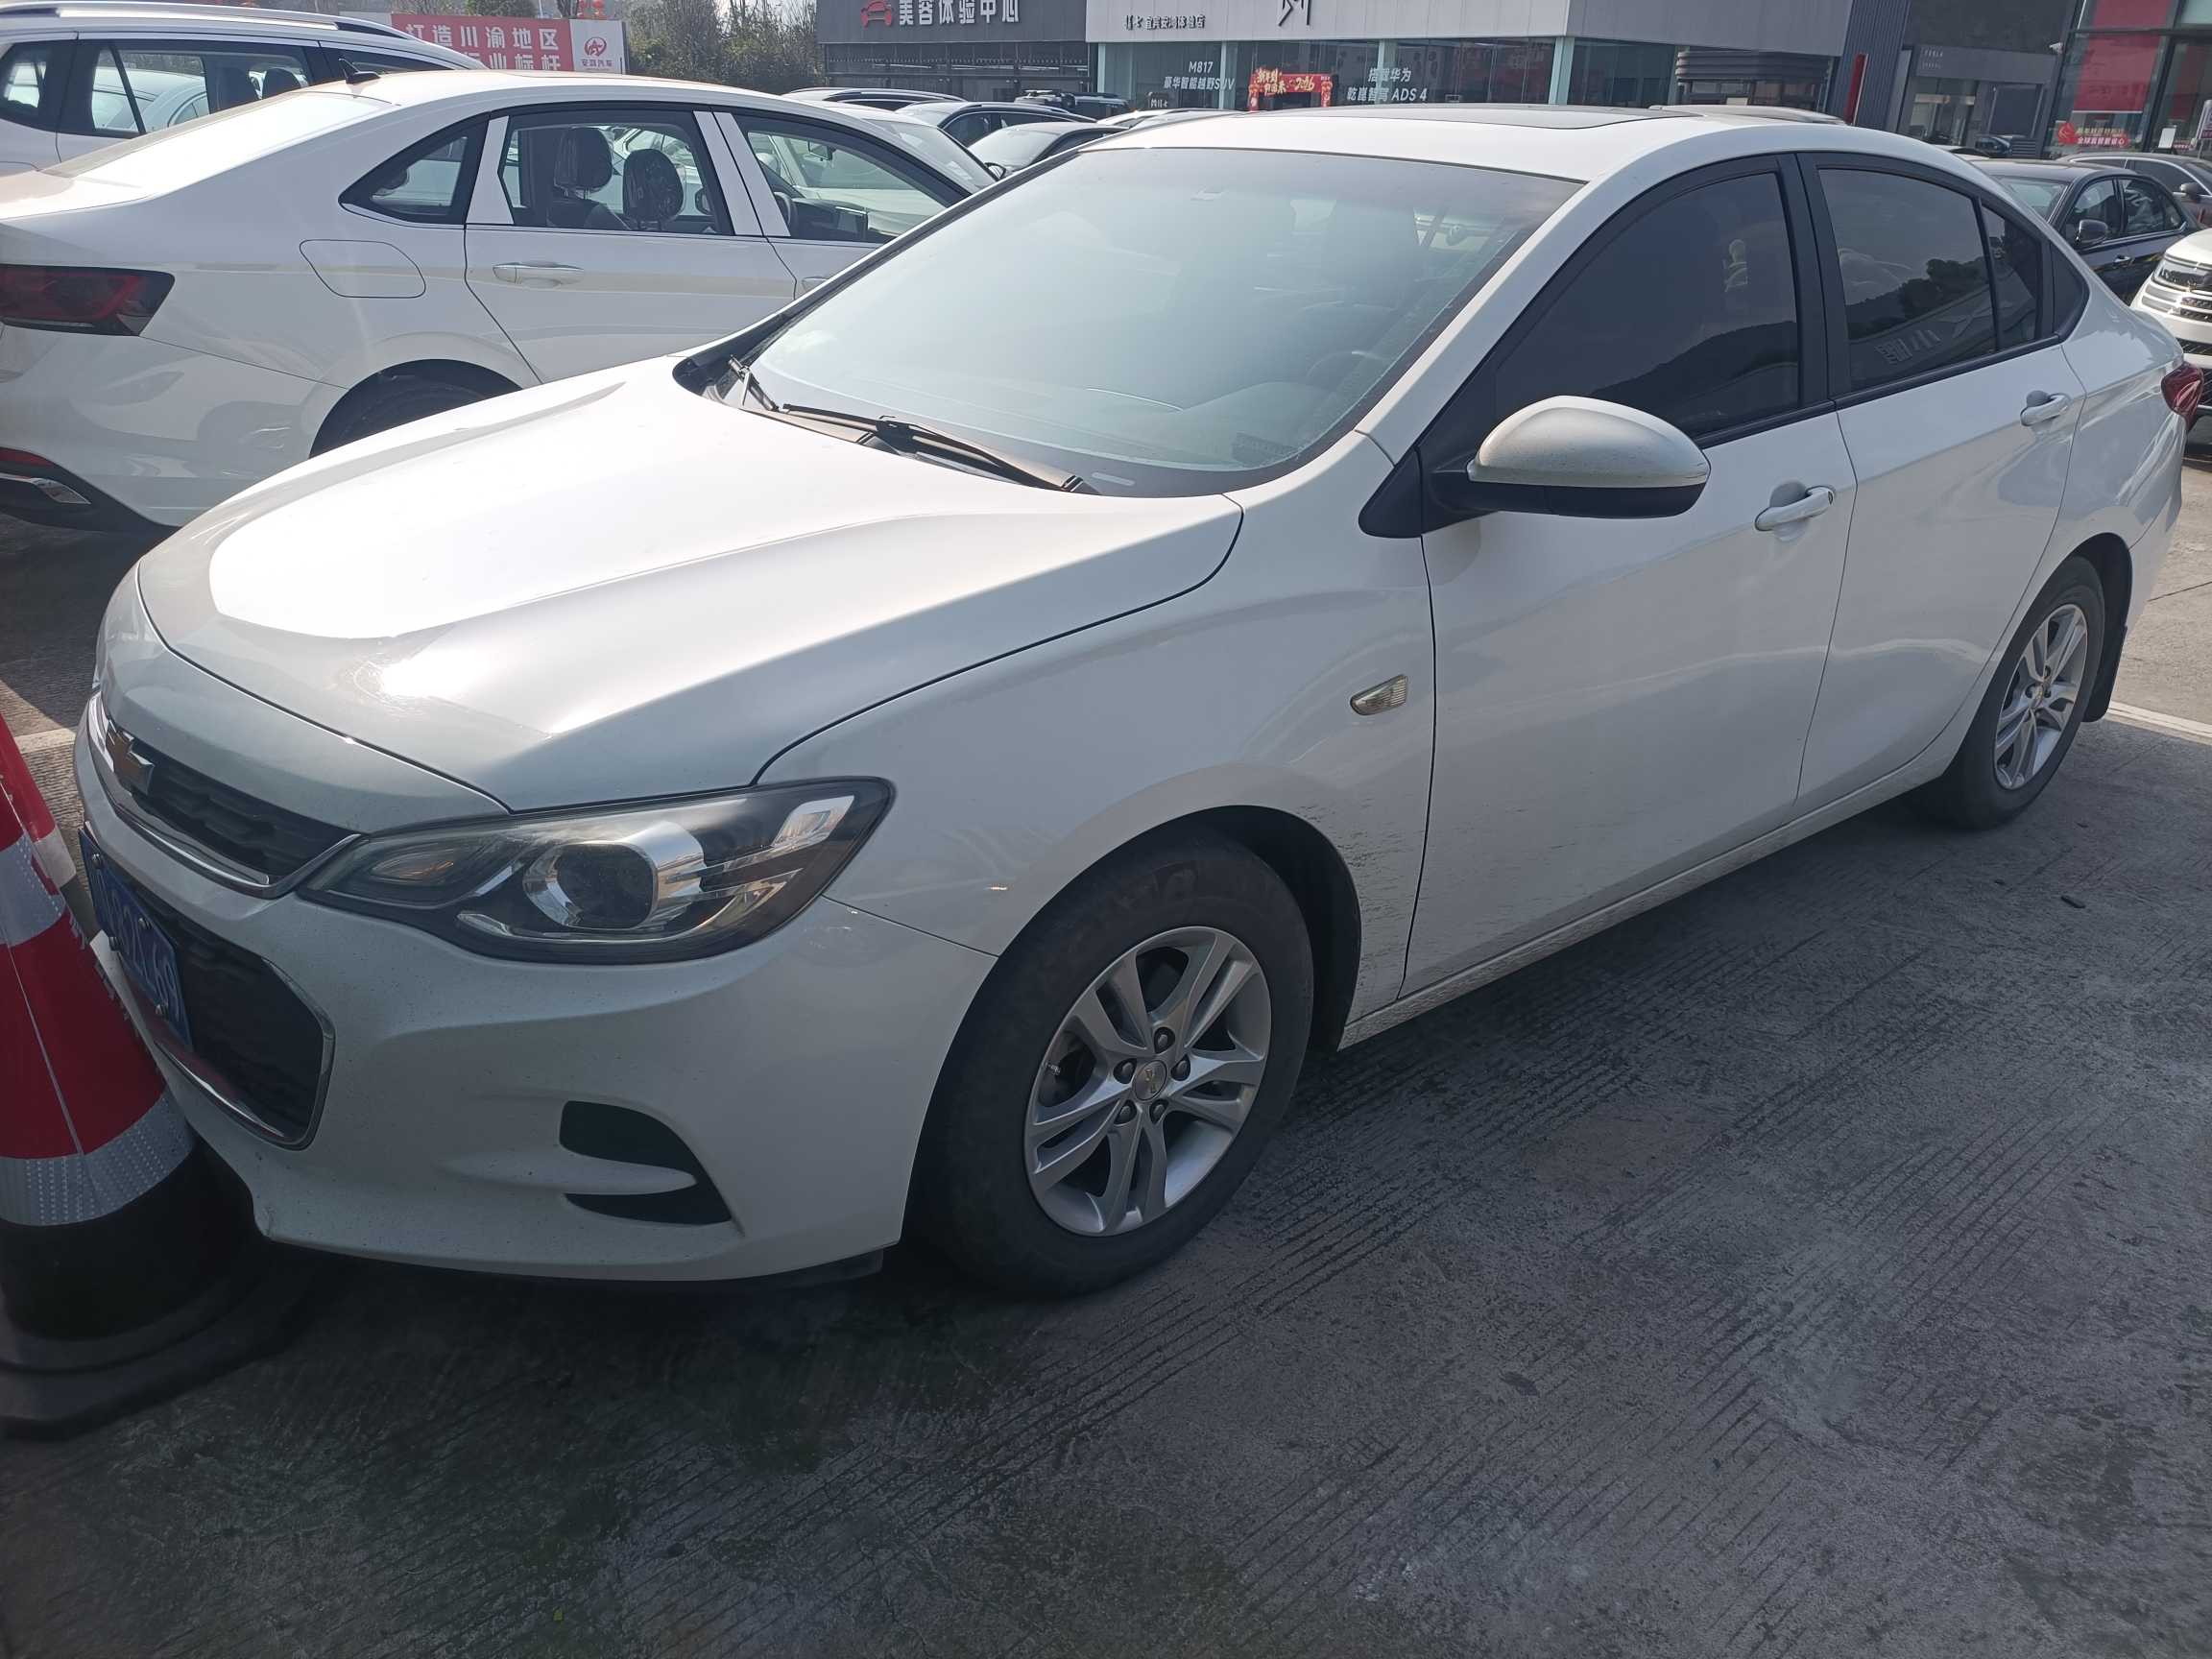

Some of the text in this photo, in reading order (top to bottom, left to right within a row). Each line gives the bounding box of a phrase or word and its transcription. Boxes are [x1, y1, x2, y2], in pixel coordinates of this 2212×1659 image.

[900, 0, 1020, 25] 美容体验中心
[406, 24, 559, 51] 打造川渝地区
[1189, 60, 1214, 74] M817
[1391, 87, 1417, 101] ADS
[1419, 88, 1428, 101] 4
